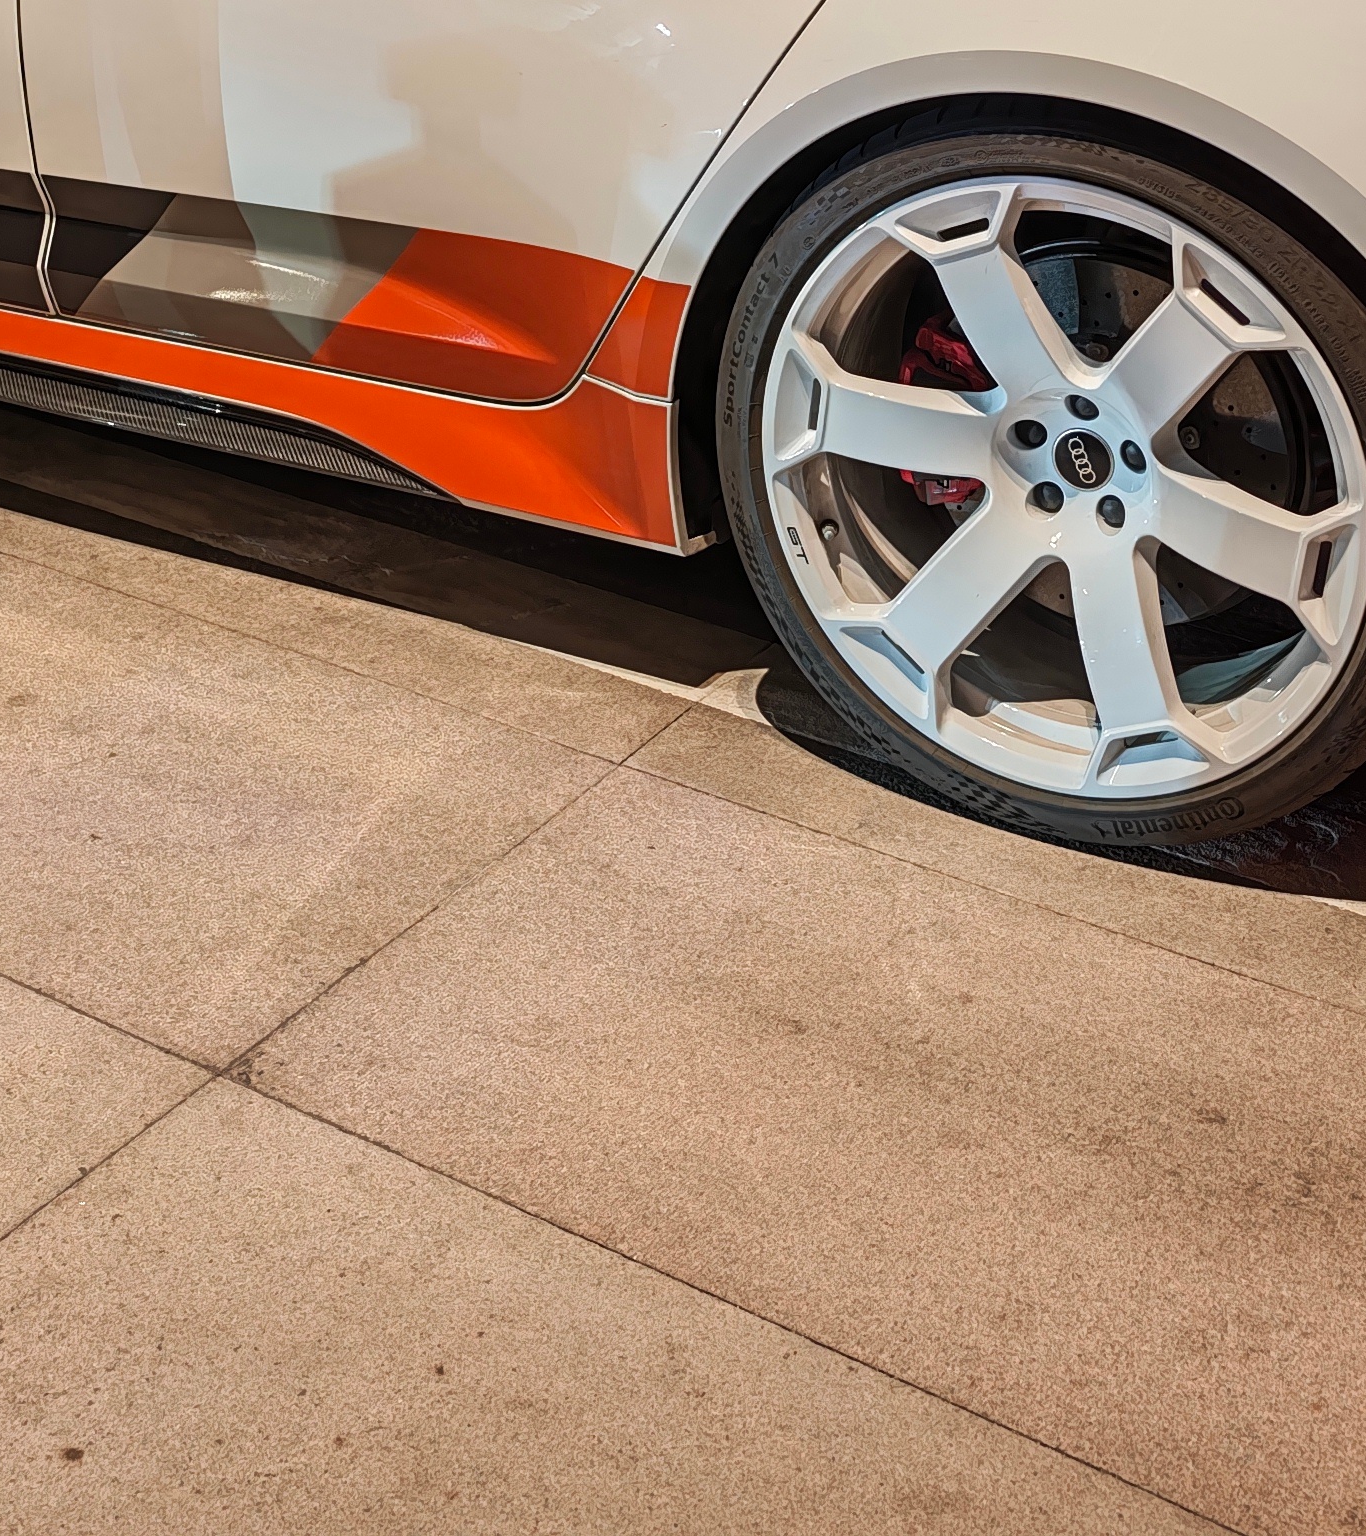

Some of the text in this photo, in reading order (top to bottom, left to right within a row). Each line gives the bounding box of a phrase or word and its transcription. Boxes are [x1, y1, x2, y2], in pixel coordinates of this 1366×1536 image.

[723, 252, 779, 428] SportContact 7
[787, 527, 809, 564] GT
[1110, 796, 1245, 839] Continental
